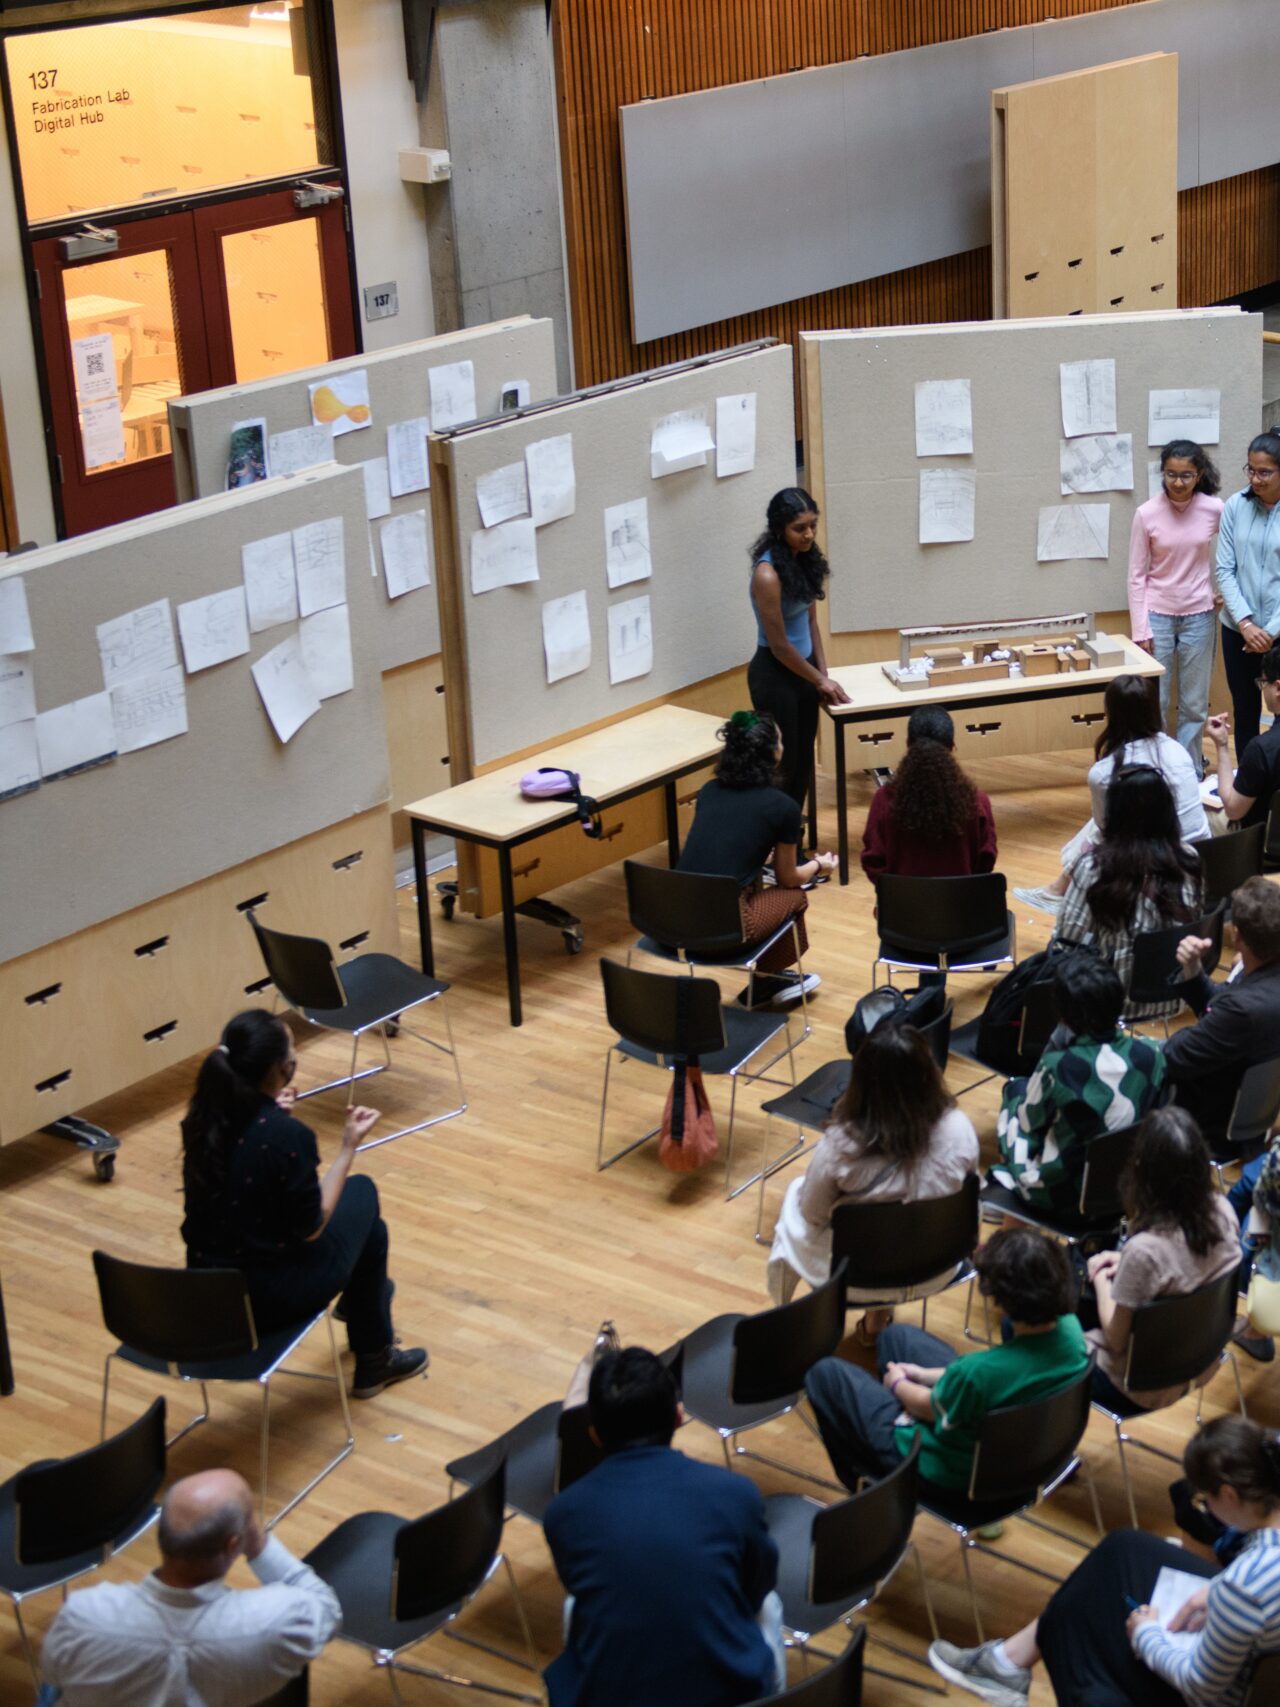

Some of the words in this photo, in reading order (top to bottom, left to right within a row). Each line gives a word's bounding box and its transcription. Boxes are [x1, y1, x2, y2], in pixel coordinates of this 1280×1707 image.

[28, 69, 58, 90] 137
[32, 94, 102, 115] Fabrication
[107, 88, 130, 103] Lab
[34, 114, 75, 133] Digital
[80, 110, 104, 125] Hub
[373, 293, 390, 307] 137
